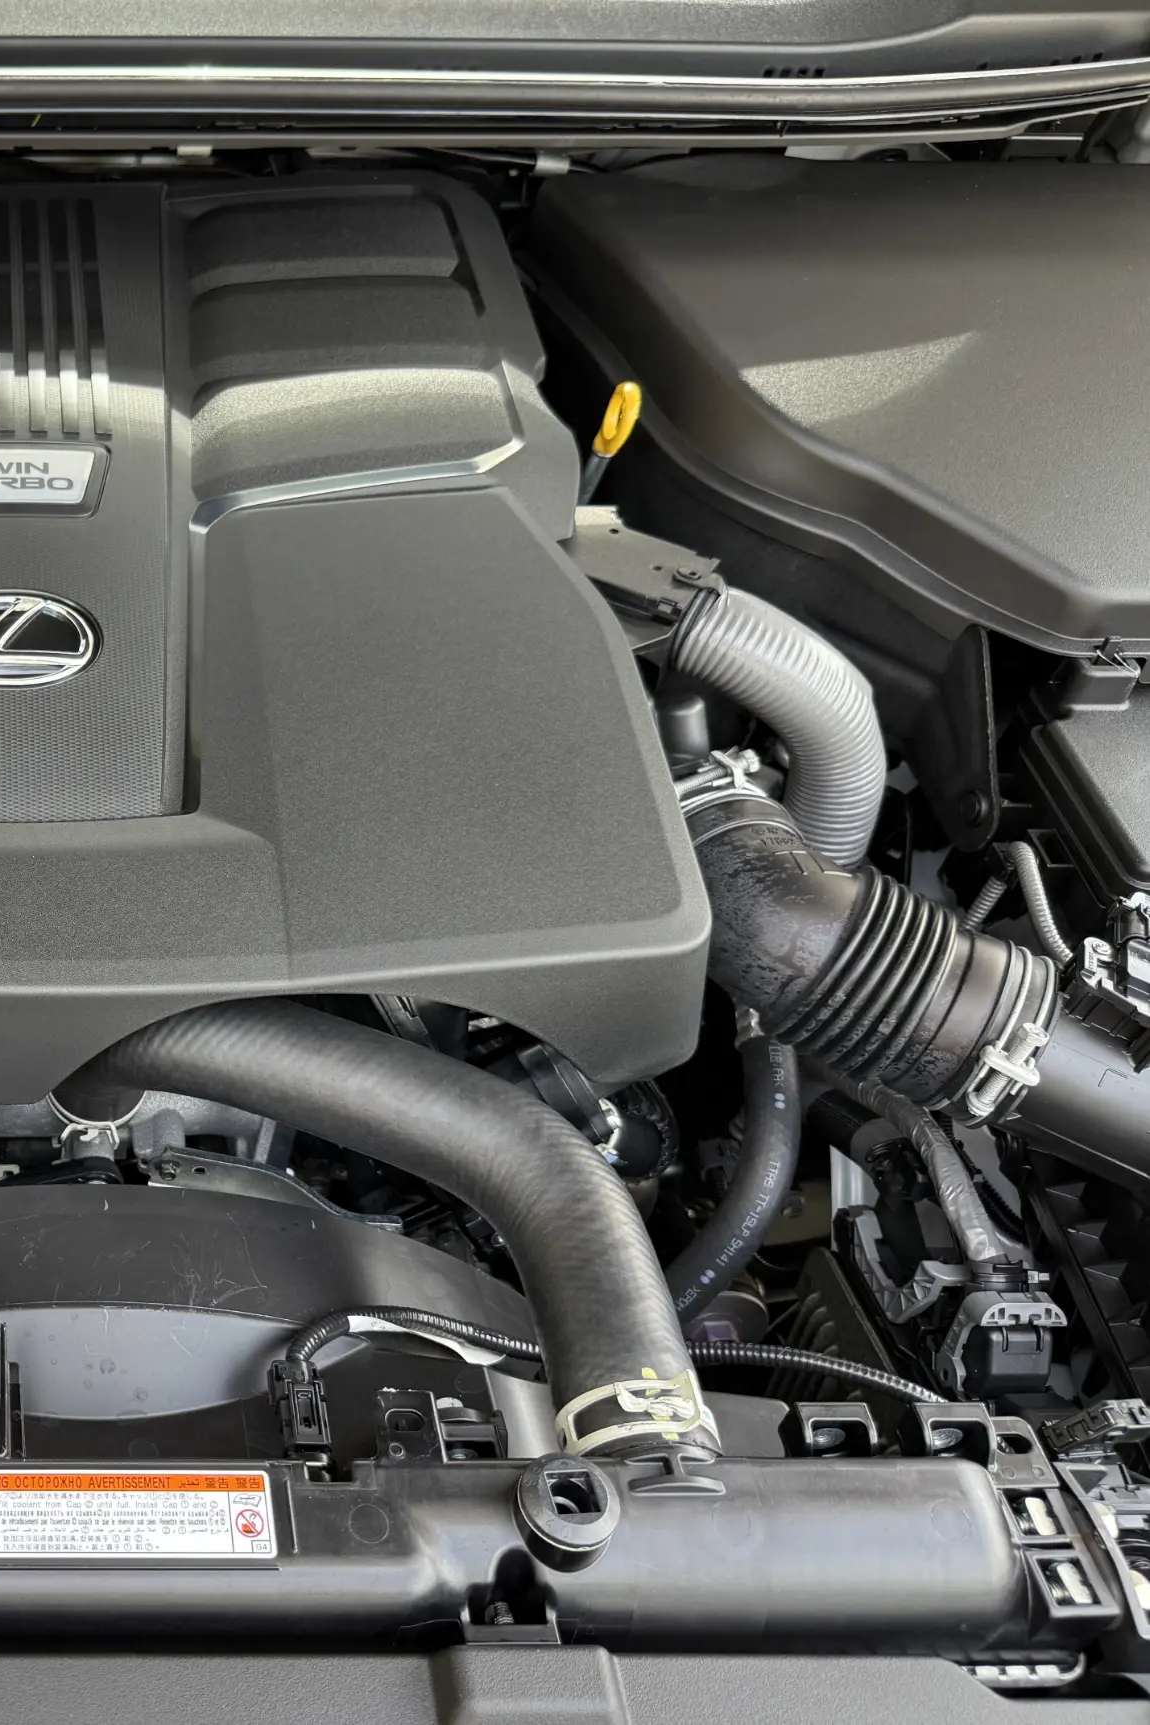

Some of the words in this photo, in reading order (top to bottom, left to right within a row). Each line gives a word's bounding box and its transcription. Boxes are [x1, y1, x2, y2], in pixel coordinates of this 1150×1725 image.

[14, 1476, 83, 1488] ОСТОРОЖНО
[88, 1476, 172, 1488] AVERTISSEMENT
[205, 1476, 229, 1489] 警告
[236, 1476, 260, 1489] 警告
[12, 1500, 41, 1508] coolant
[45, 1500, 62, 1508] from
[66, 1500, 81, 1508] Cap
[162, 1500, 178, 1508] Cap
[192, 1500, 207, 1508] and
[255, 1543, 268, 1551] G4
